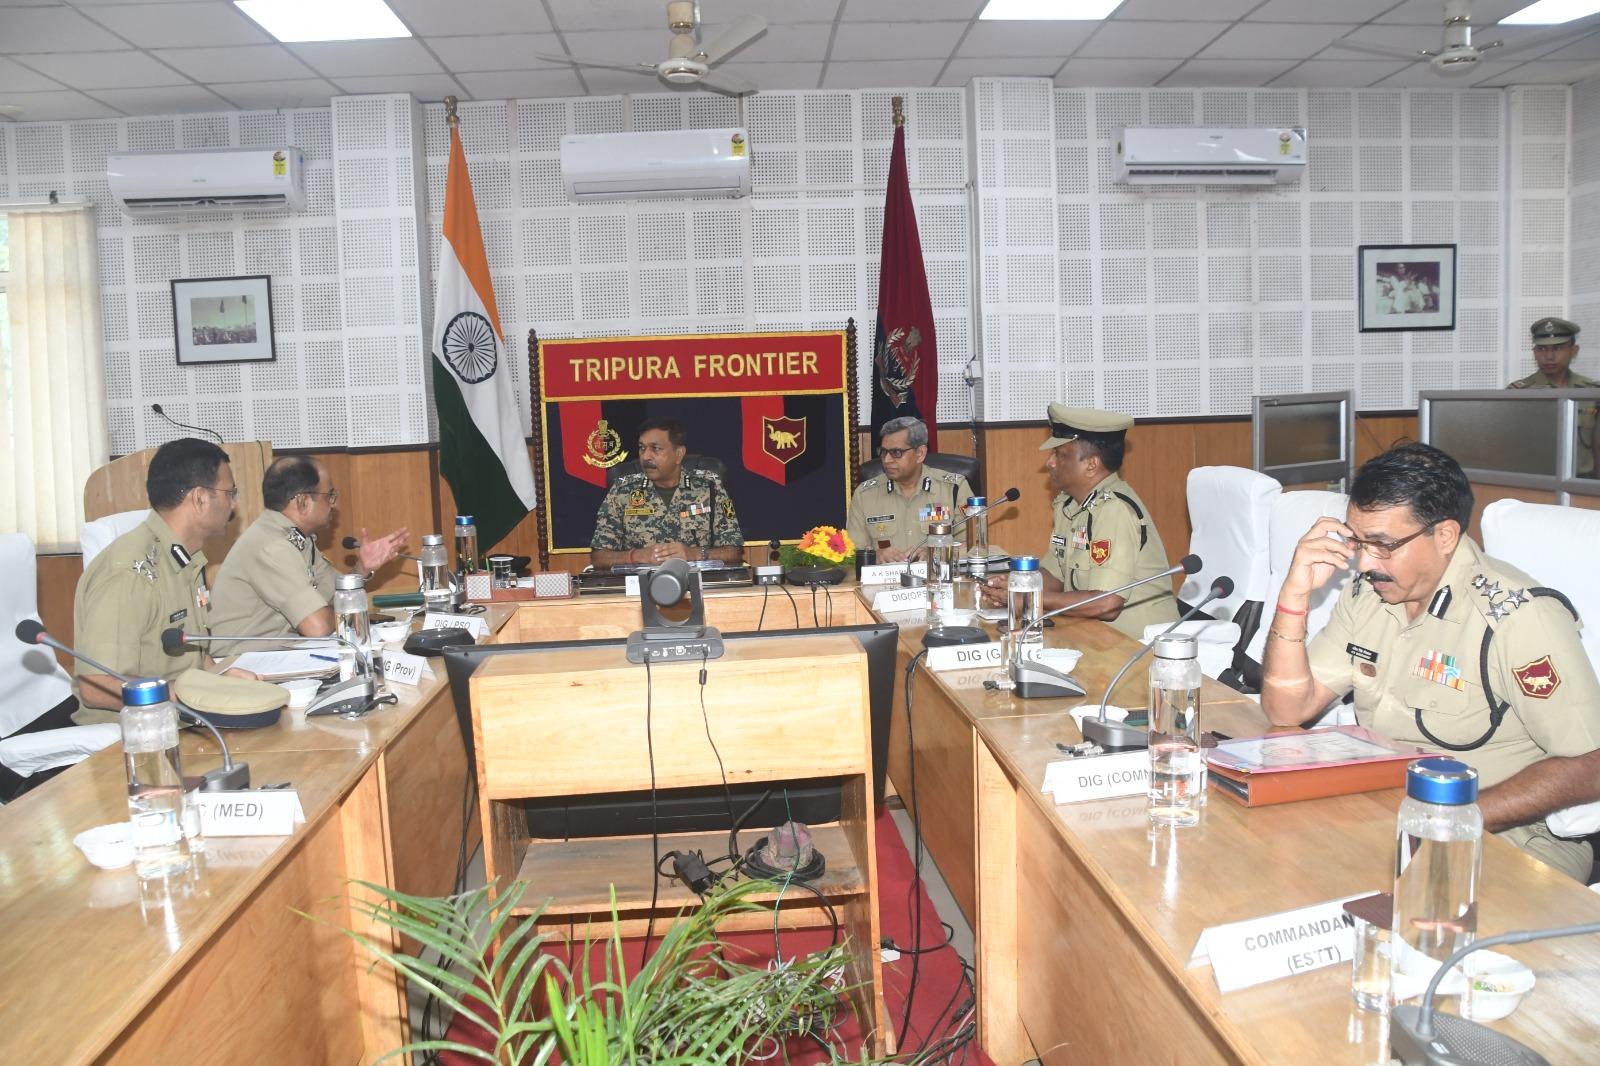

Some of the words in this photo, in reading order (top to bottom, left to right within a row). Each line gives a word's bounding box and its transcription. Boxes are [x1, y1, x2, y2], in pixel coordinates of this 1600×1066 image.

[569, 356, 681, 382] TRIPURA
[694, 351, 819, 378] FRONTIER
[434, 619, 449, 628] DIG
[957, 650, 982, 662] DIG
[392, 662, 416, 679] (Prov)
[1078, 774, 1103, 788] DIG
[213, 803, 264, 820] (MED)
[1244, 913, 1356, 952] COMMANDAN
[1287, 944, 1342, 975] (ESTT)
